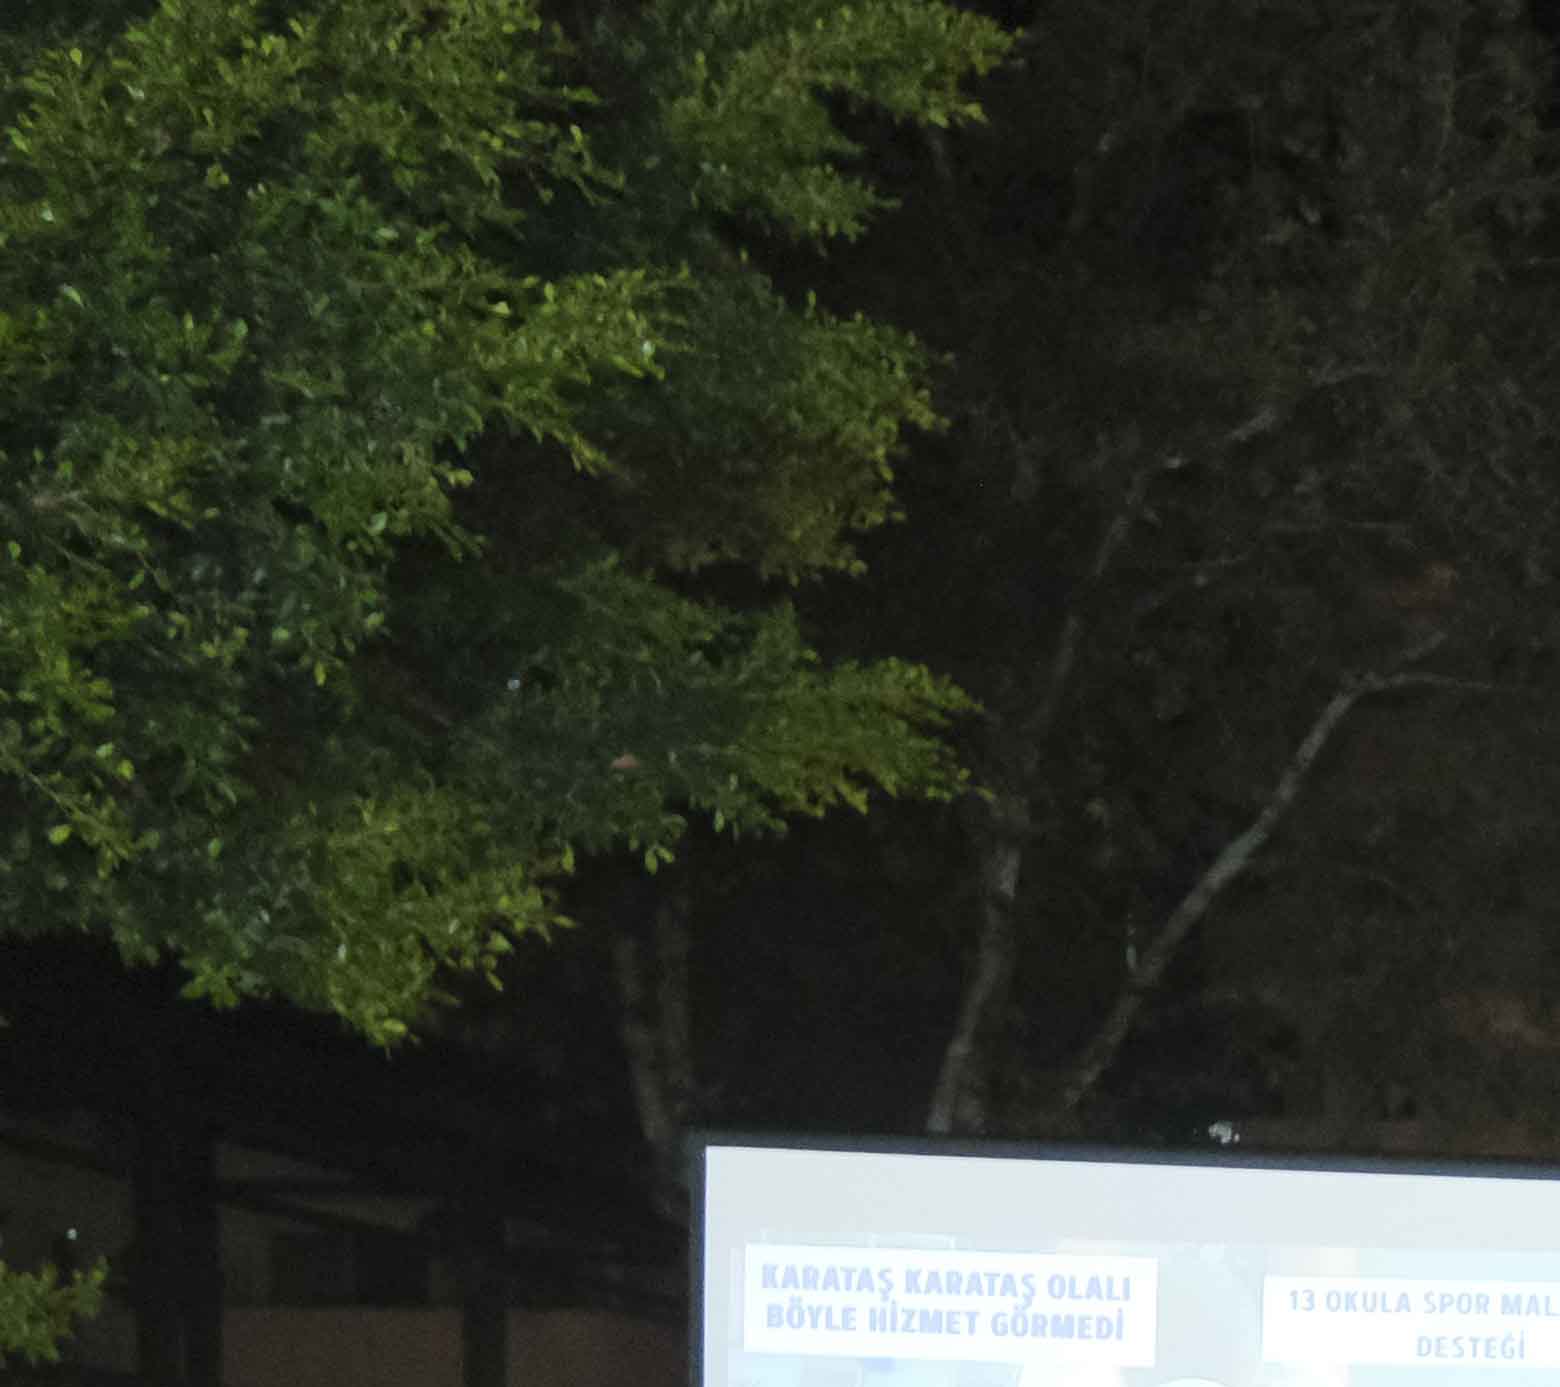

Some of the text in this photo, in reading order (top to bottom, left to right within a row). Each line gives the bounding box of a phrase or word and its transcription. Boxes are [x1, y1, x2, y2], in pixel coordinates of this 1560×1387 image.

[761, 1263, 1131, 1311] KARATAŞ KARATAŞ OLALI
[1289, 1290, 1316, 1313] 13
[1326, 1290, 1411, 1314] OKULA
[1423, 1291, 1490, 1316] SPOR
[766, 1297, 1124, 1341] BÖYLE HİZMET GÖRMEDİ
[1416, 1330, 1525, 1360] DESTEĞİ
